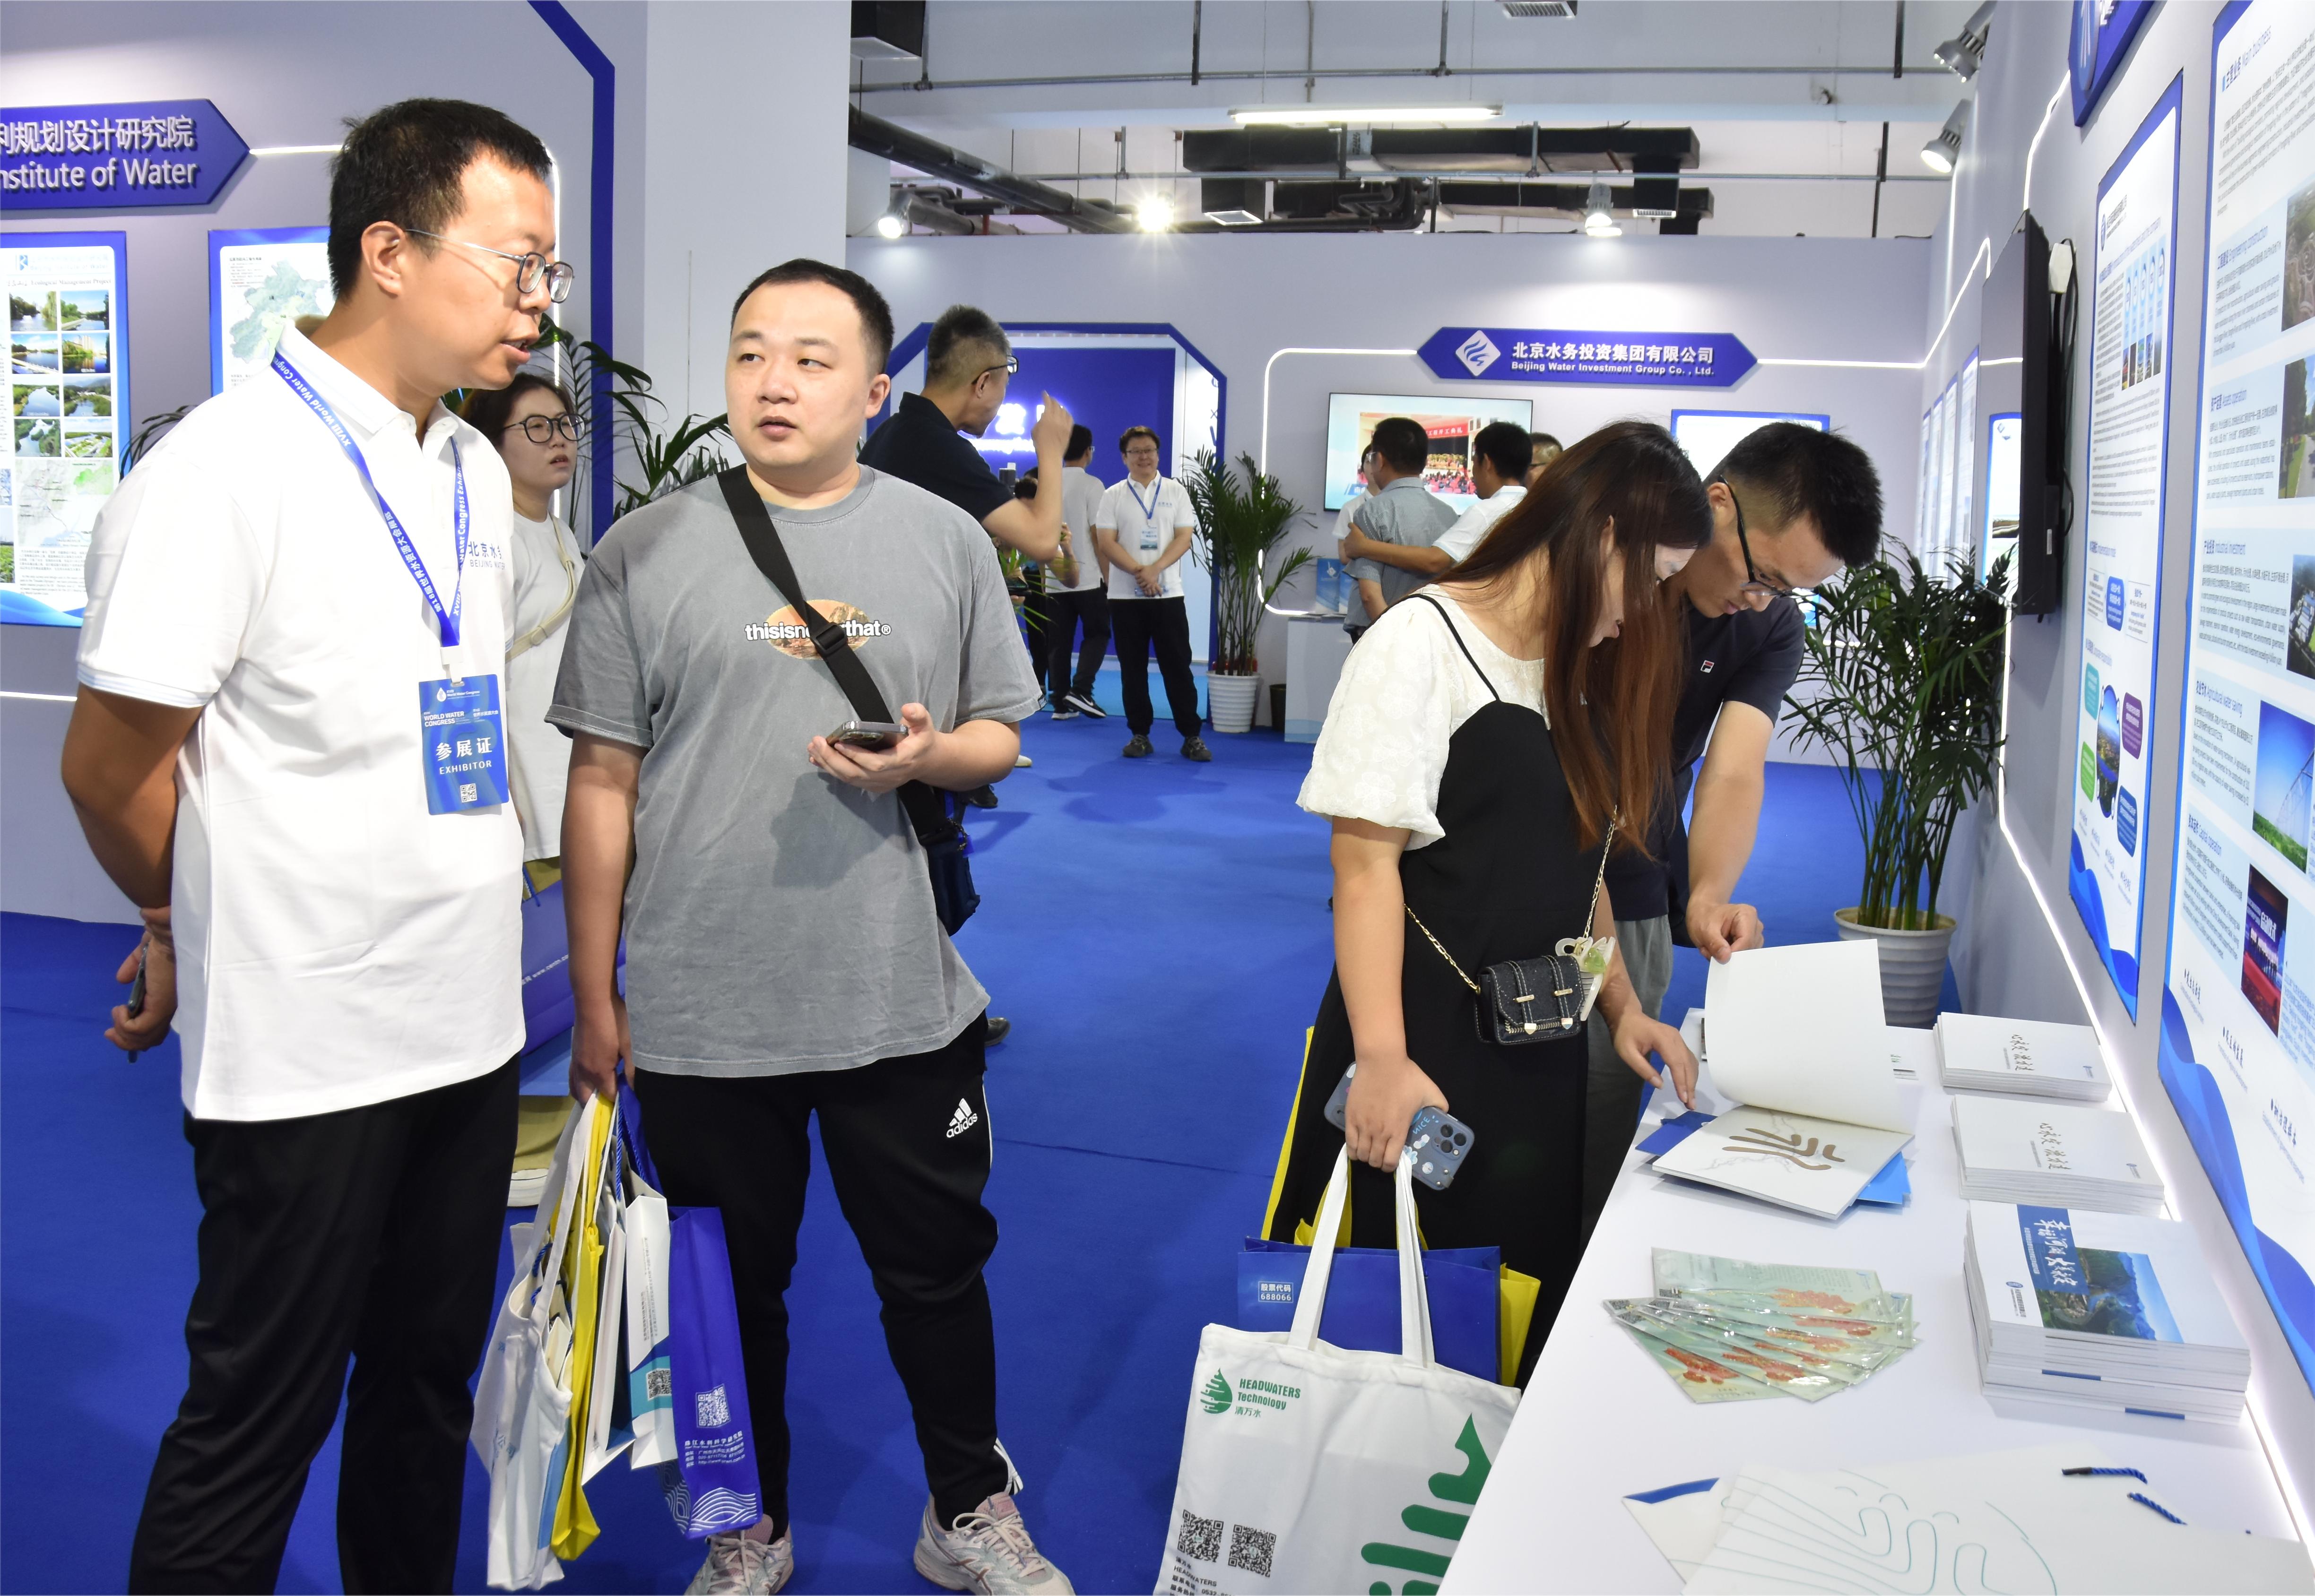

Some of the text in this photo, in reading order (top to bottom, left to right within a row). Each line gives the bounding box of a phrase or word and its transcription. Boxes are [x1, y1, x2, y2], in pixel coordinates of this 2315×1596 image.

[0, 114, 194, 155] 利规划设计研究院
[91, 157, 117, 188] of
[122, 158, 198, 185] Water
[1512, 342, 1714, 363] 北京水务投资集团有限公司
[1511, 361, 1545, 371] Beijing
[1548, 362, 1576, 371] Water
[1578, 363, 1632, 372] Investment
[1636, 364, 1666, 374] Group
[1695, 366, 1714, 375] Ltd.
[292, 378, 313, 401] Water
[310, 399, 335, 425] World
[1426, 427, 1463, 435] 工程开工典礼
[458, 496, 468, 535] Congress
[470, 560, 493, 568] BEIJING
[424, 713, 445, 721] WORLD
[425, 718, 455, 727] CONGRESS
[436, 737, 493, 761] 参展证
[439, 760, 492, 775] EXHIBITOR
[946, 1113, 978, 1138] adidas
[1261, 1283, 1291, 1292] 股票代码
[1239, 1378, 1301, 1398] HEADWATERS
[1238, 1392, 1287, 1410] Technology
[1235, 1406, 1262, 1418] 清万水
[1174, 1565, 1217, 1587] HEADWATERS
